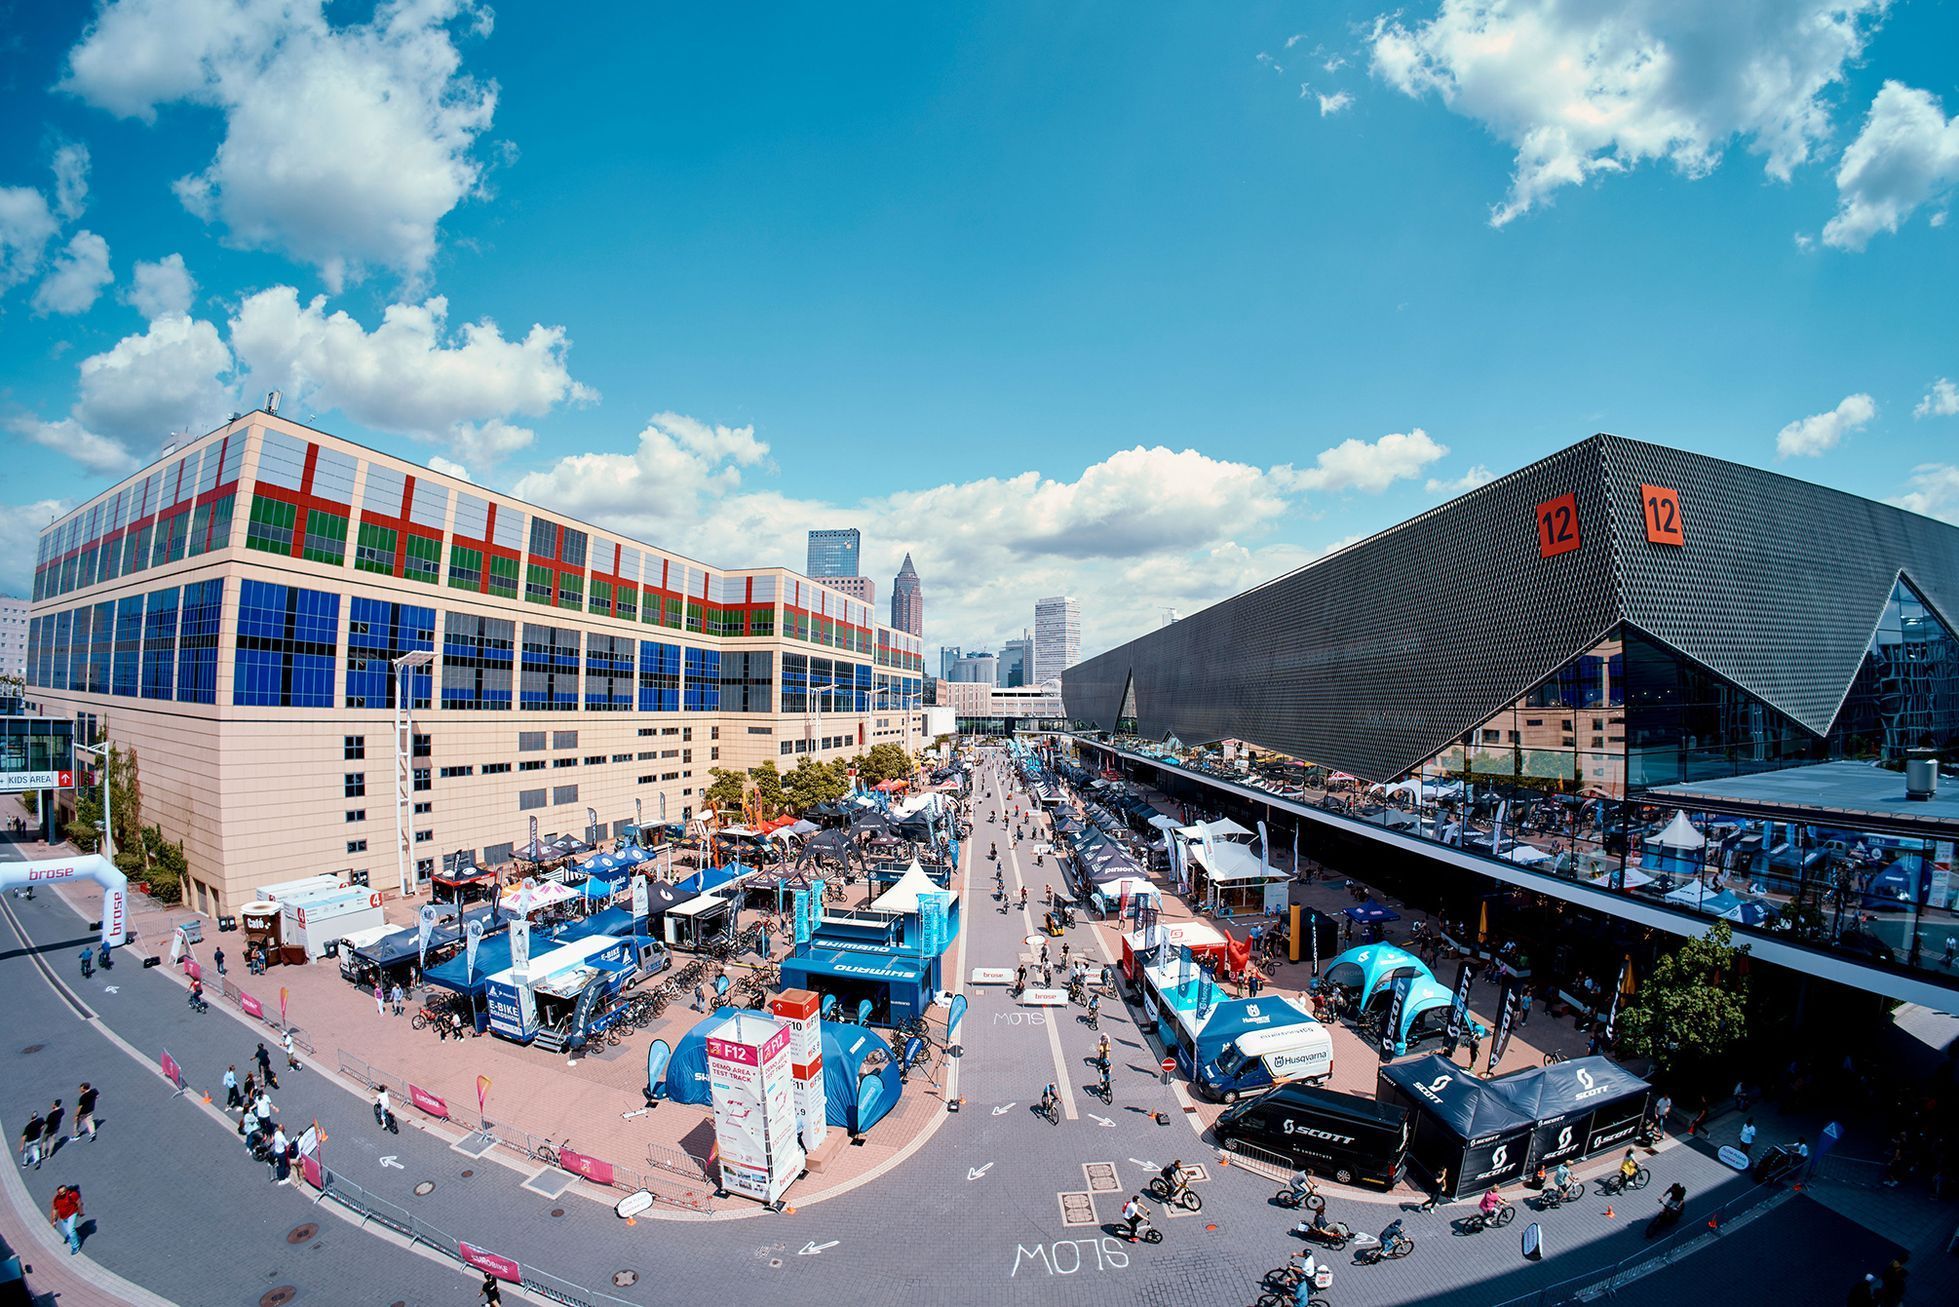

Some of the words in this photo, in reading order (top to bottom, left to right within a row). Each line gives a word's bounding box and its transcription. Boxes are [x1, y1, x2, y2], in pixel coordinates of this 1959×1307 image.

[1649, 497, 1678, 533] 12
[1542, 506, 1573, 545] 12
[8, 776, 28, 784] KIDS
[30, 775, 52, 783] AREA
[29, 867, 74, 881] brose
[1105, 866, 1135, 875] pinion
[371, 894, 381, 907] 4
[109, 891, 123, 937] brose
[298, 908, 305, 923] 4
[924, 909, 932, 931] DEMO
[816, 940, 890, 953] SHIMANO
[833, 964, 917, 978] SHIMANO
[1452, 966, 1472, 1024] SCOTT
[489, 1000, 519, 1016] E-BIKE
[1387, 977, 1406, 1039] SCOTT
[994, 1012, 1046, 1025] SLOW
[1496, 988, 1516, 1053] SCOTT
[771, 1033, 784, 1054] F12
[907, 1038, 921, 1060] SHIMANO
[725, 1044, 747, 1061] F12
[1284, 1050, 1327, 1067] Husqvarna
[712, 1062, 731, 1072] DEMO
[733, 1067, 751, 1076] AREA
[713, 1068, 728, 1077] TEST
[730, 1073, 752, 1083] TRACK
[1413, 1081, 1444, 1104] SCOTT
[1575, 1085, 1609, 1101] SCOTT
[1544, 1115, 1565, 1125] SCOTT
[1295, 1126, 1355, 1144] SCOTT
[1475, 1134, 1500, 1144] SCOTT
[1601, 1126, 1636, 1144] SCOTT
[1542, 1143, 1579, 1160] SCOTT
[1475, 1162, 1517, 1180] SCOTT
[471, 1254, 508, 1273] EUROBIKE
[1011, 1237, 1129, 1277] SLOW
